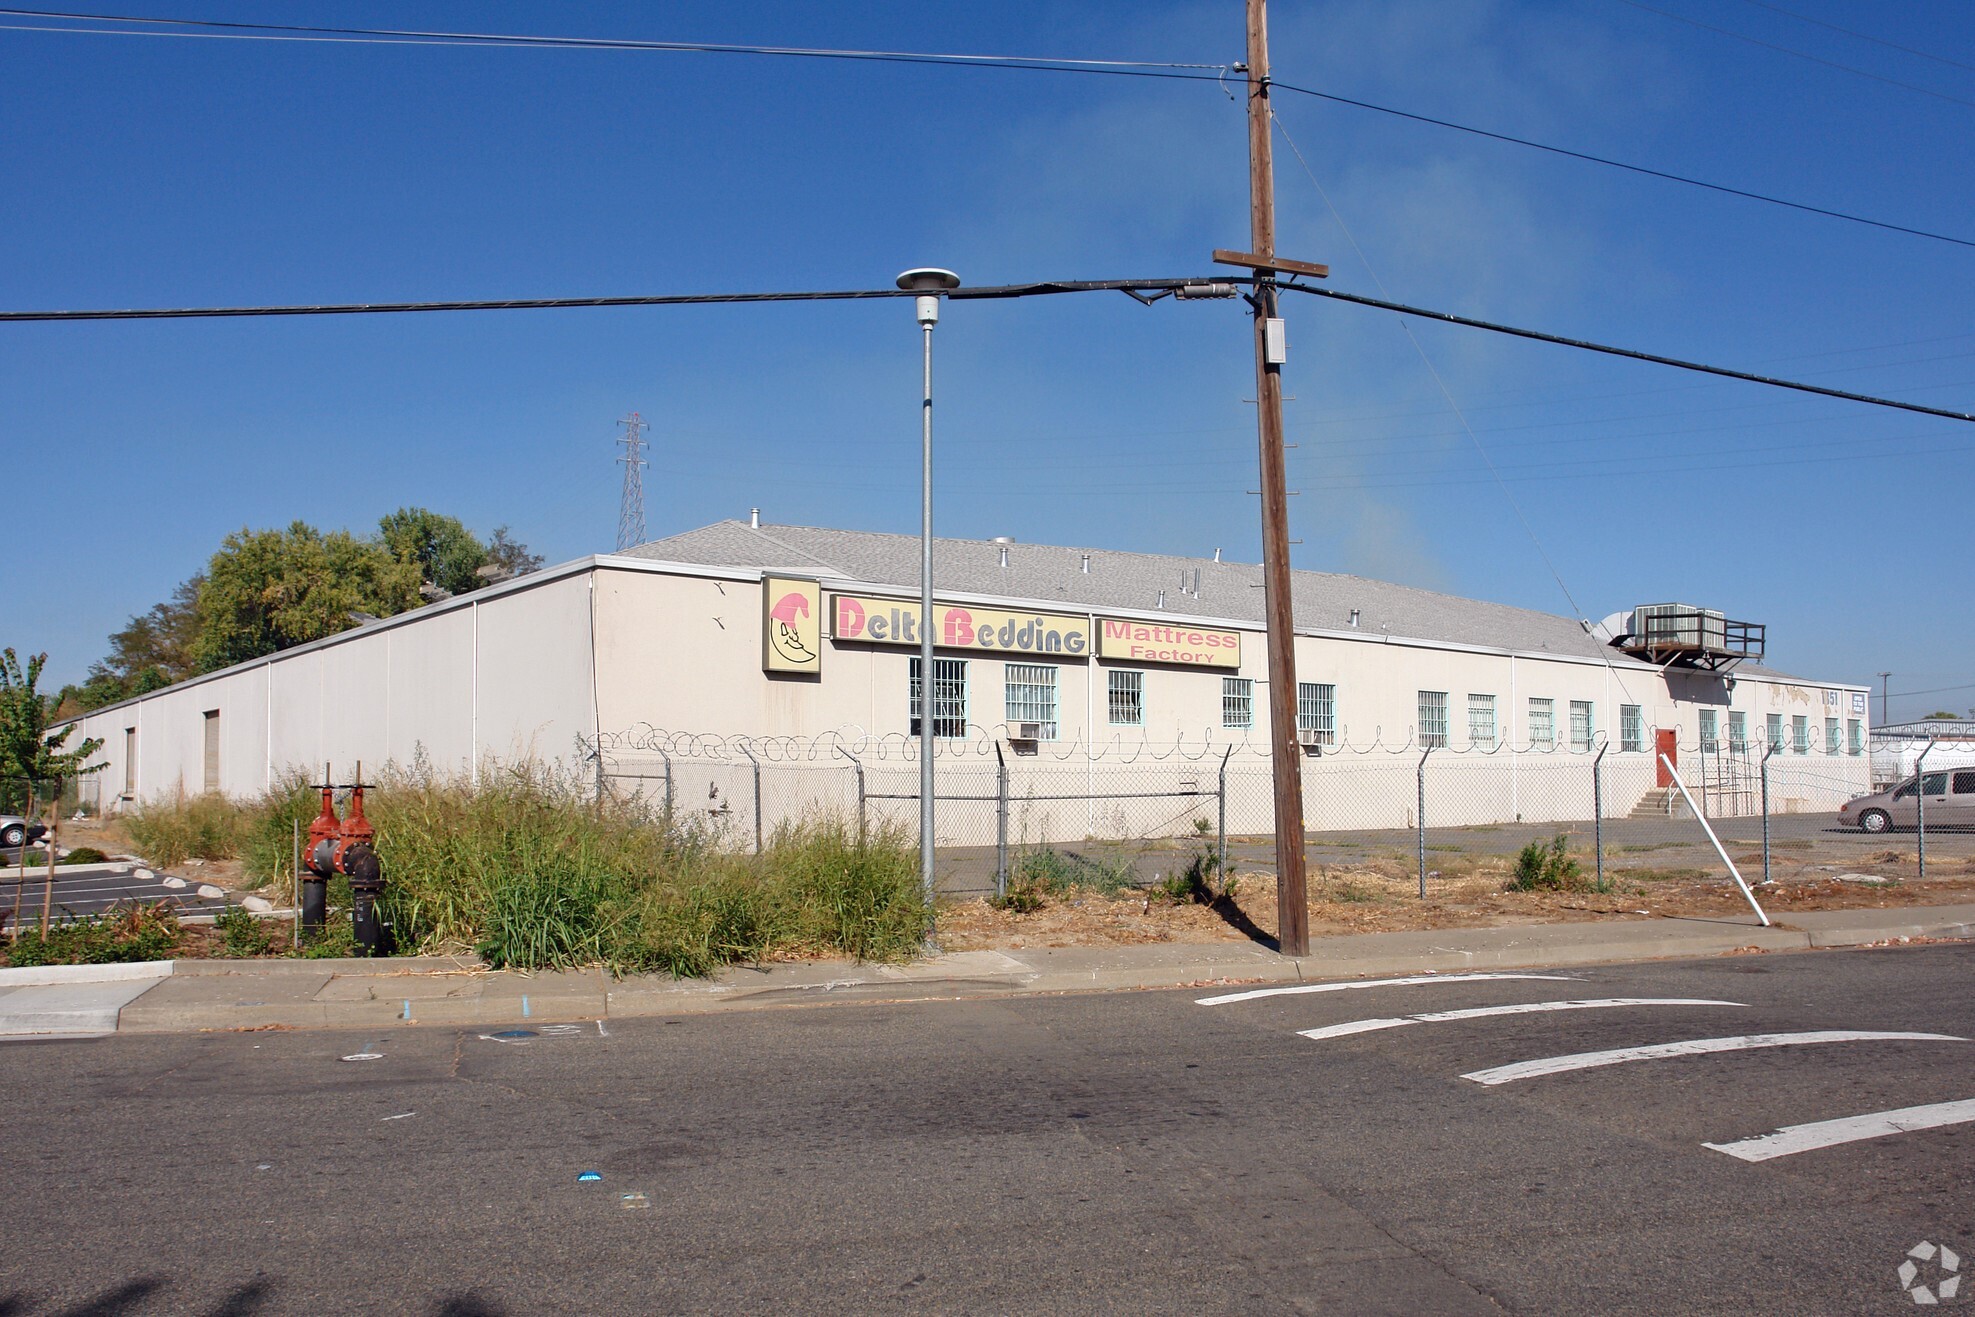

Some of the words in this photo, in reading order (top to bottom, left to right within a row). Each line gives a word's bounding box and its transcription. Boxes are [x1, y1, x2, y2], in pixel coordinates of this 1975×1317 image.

[944, 608, 1086, 654] Bedding
[1105, 621, 1237, 648] Mattress
[1130, 645, 1215, 663] Factory
